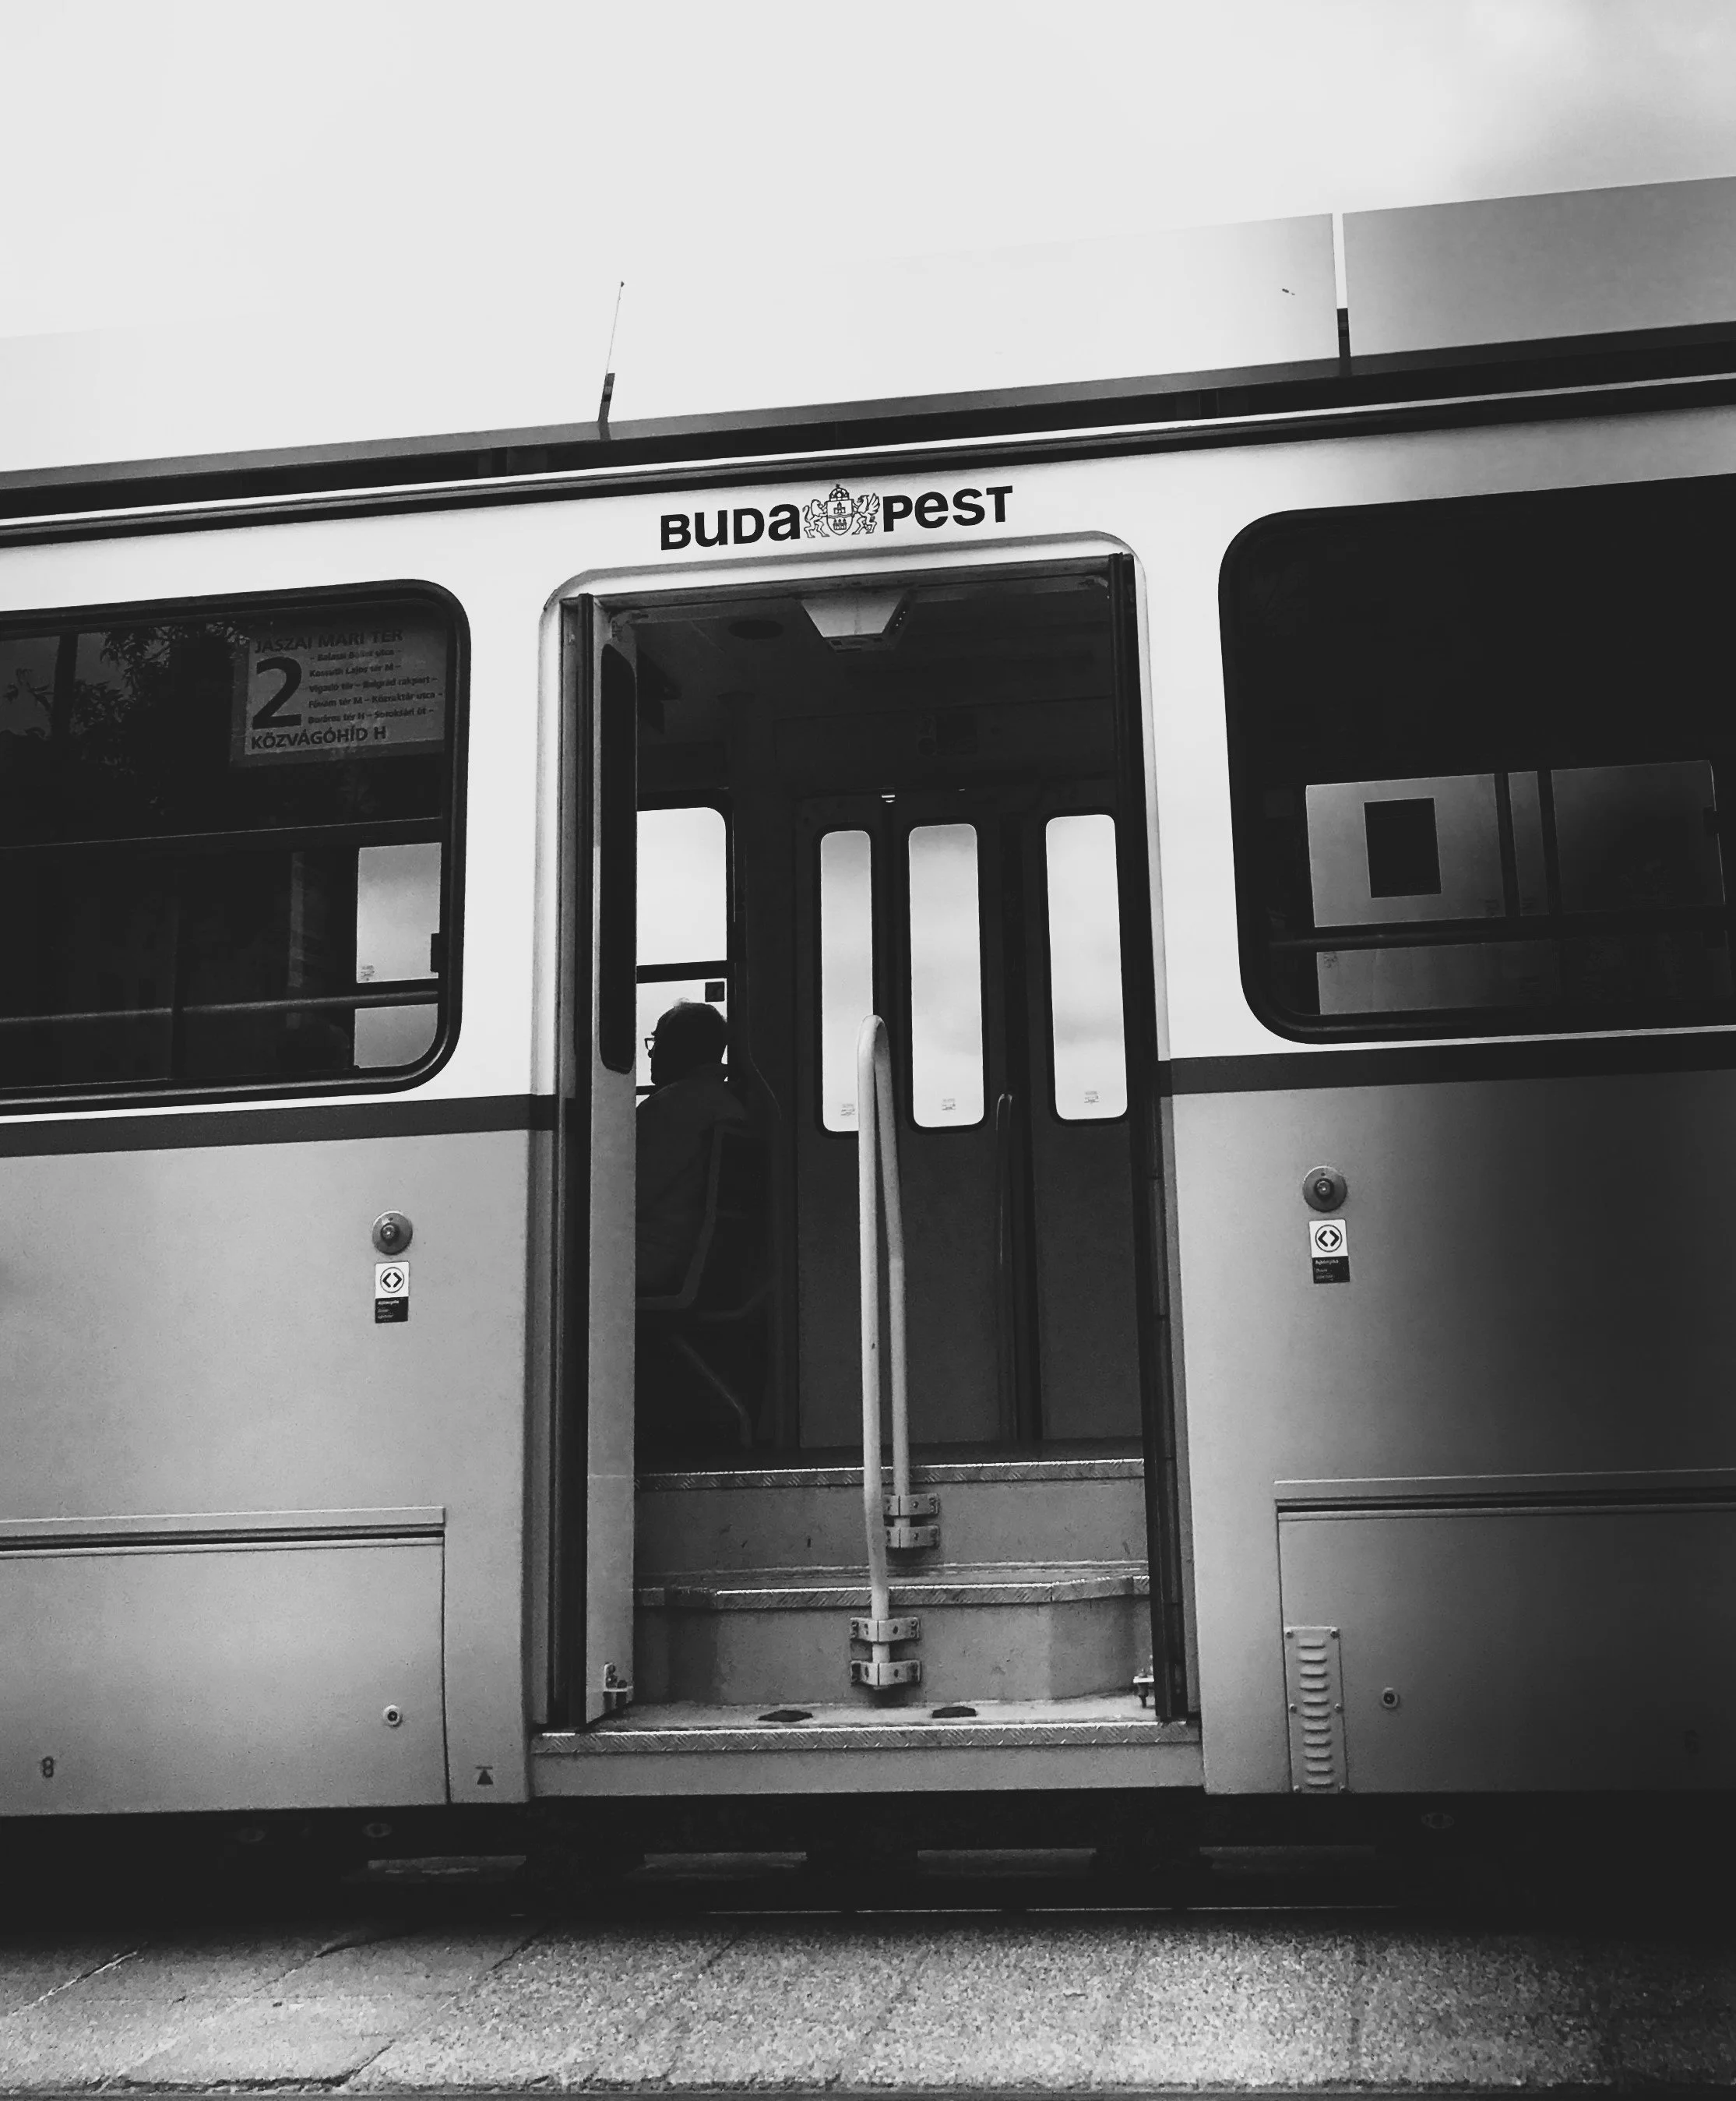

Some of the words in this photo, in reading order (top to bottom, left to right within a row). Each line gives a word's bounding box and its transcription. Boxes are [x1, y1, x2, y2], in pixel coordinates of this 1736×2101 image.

[318, 631, 364, 647] MARI
[252, 656, 302, 730] 2
[251, 727, 368, 749] KÖZVÁGÓHÍD
[374, 725, 387, 740] H
